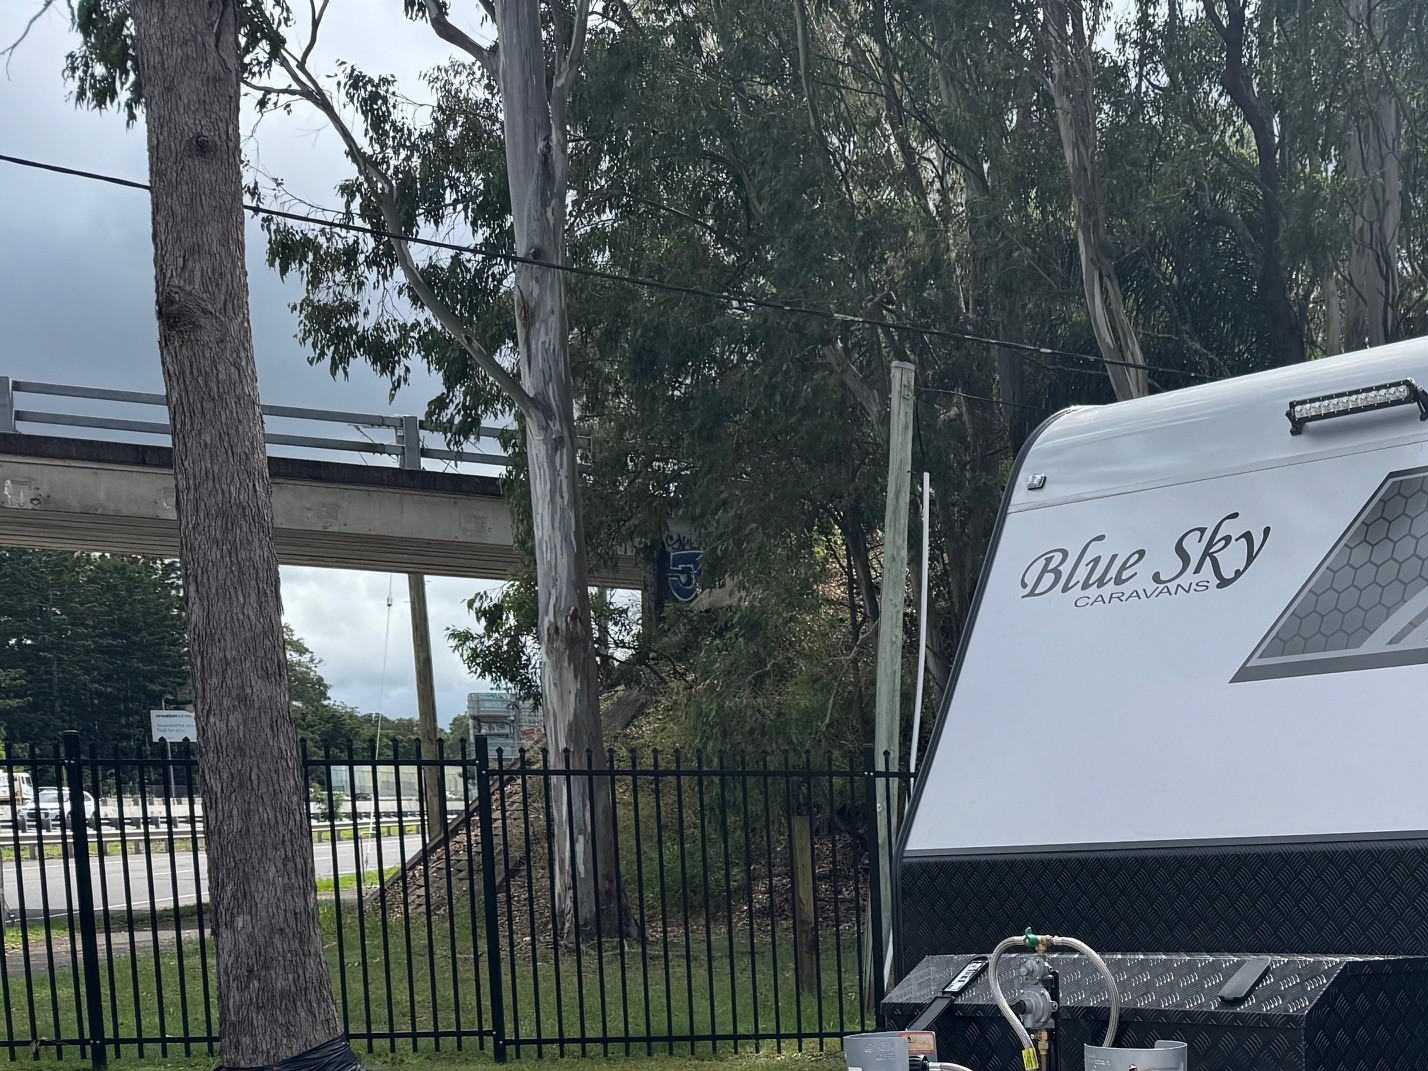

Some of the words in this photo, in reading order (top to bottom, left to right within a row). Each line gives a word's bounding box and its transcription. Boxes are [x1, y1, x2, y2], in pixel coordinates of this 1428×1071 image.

[1020, 534, 1146, 599] Blue
[1152, 511, 1272, 590] Sky
[1074, 580, 1210, 608] CARAVANS
